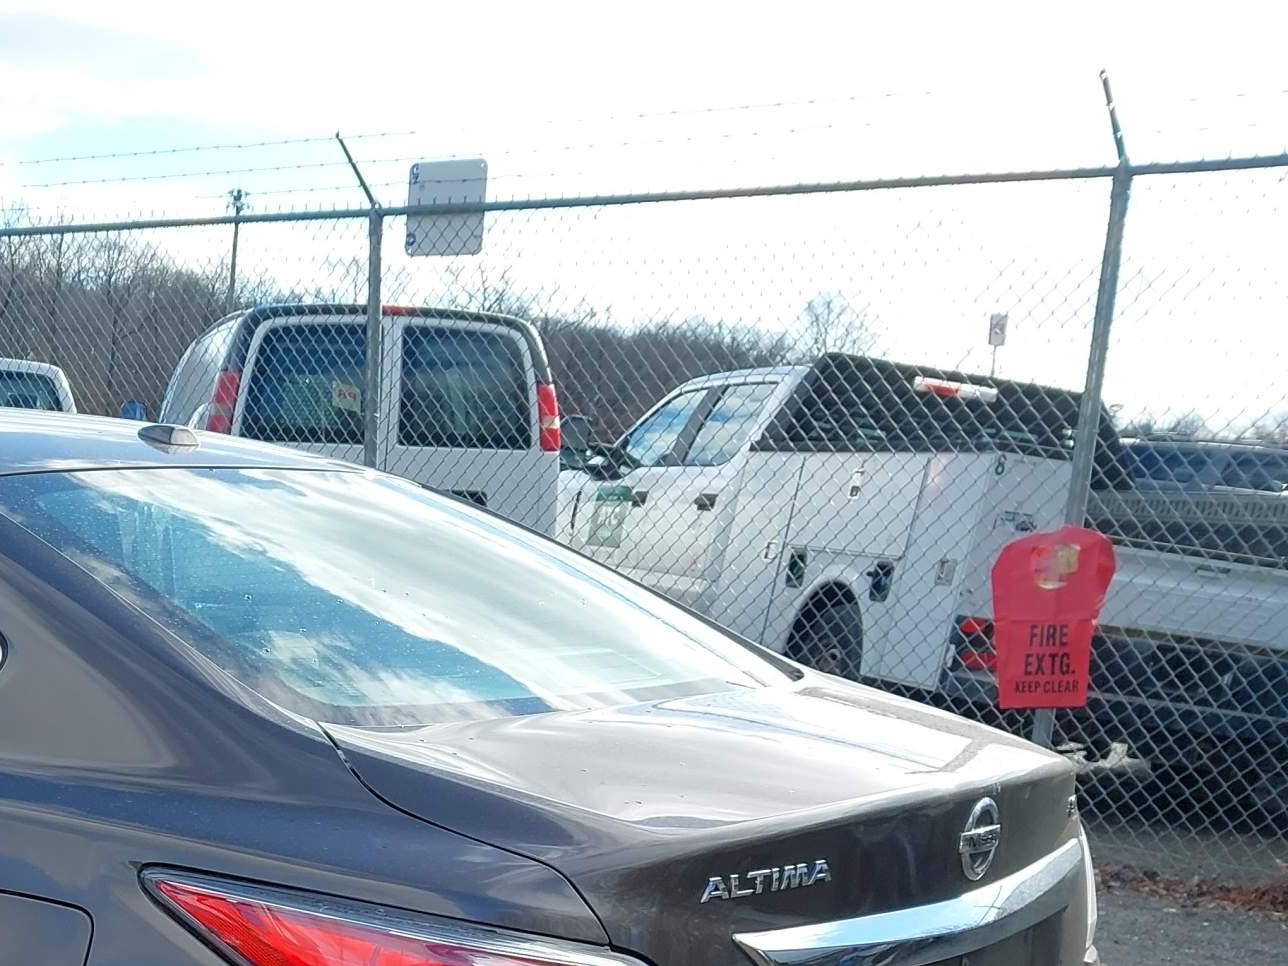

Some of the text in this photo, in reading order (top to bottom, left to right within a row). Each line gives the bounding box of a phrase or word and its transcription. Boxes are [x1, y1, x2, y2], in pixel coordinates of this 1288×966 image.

[1028, 623, 1069, 648] FIRE
[1023, 652, 1076, 676] EXTG.
[1015, 680, 1079, 694] KEEP CLEAR
[700, 858, 833, 904] ALTIMA
